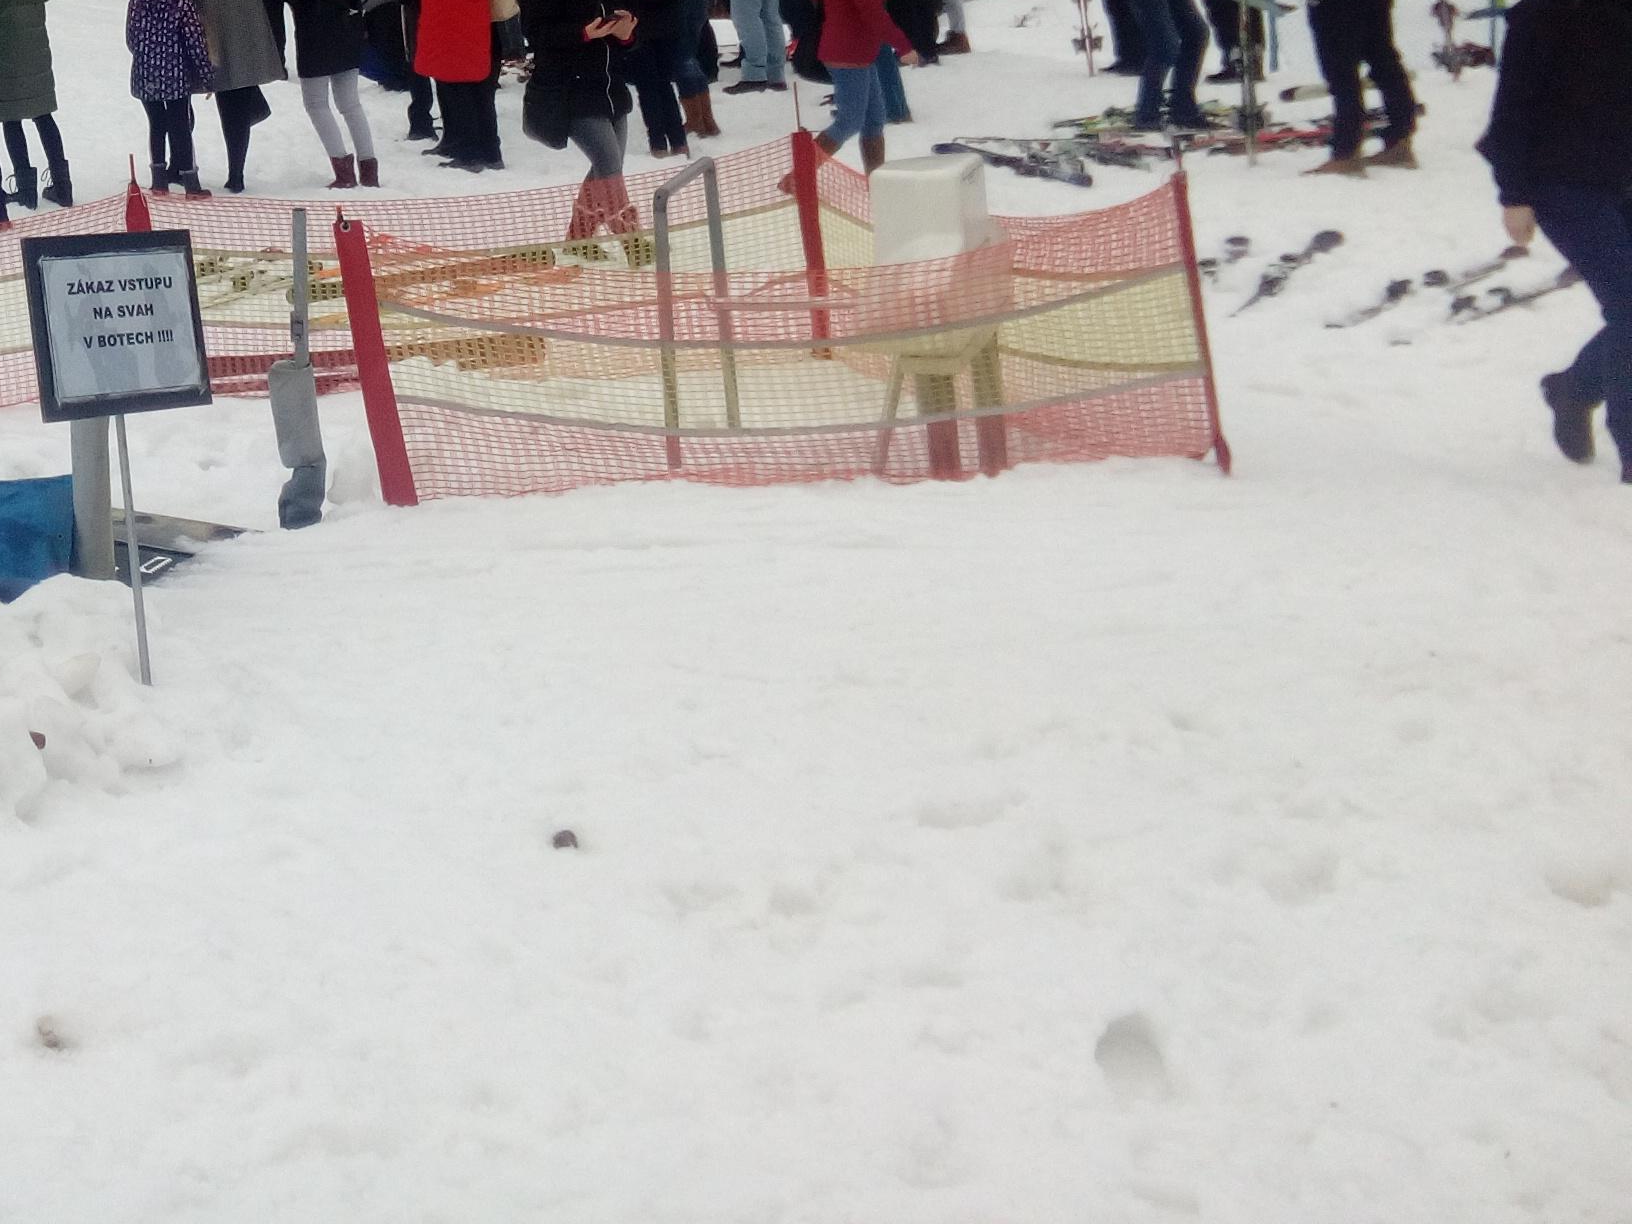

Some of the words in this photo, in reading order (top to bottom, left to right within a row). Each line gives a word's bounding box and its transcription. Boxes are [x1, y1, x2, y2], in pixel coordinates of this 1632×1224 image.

[67, 279, 115, 295] ZÁKAZ
[118, 276, 173, 291] VSTUPU
[93, 307, 113, 319] NA
[118, 304, 154, 318] SVAH
[83, 336, 93, 349] V
[97, 332, 154, 348] BOTECH
